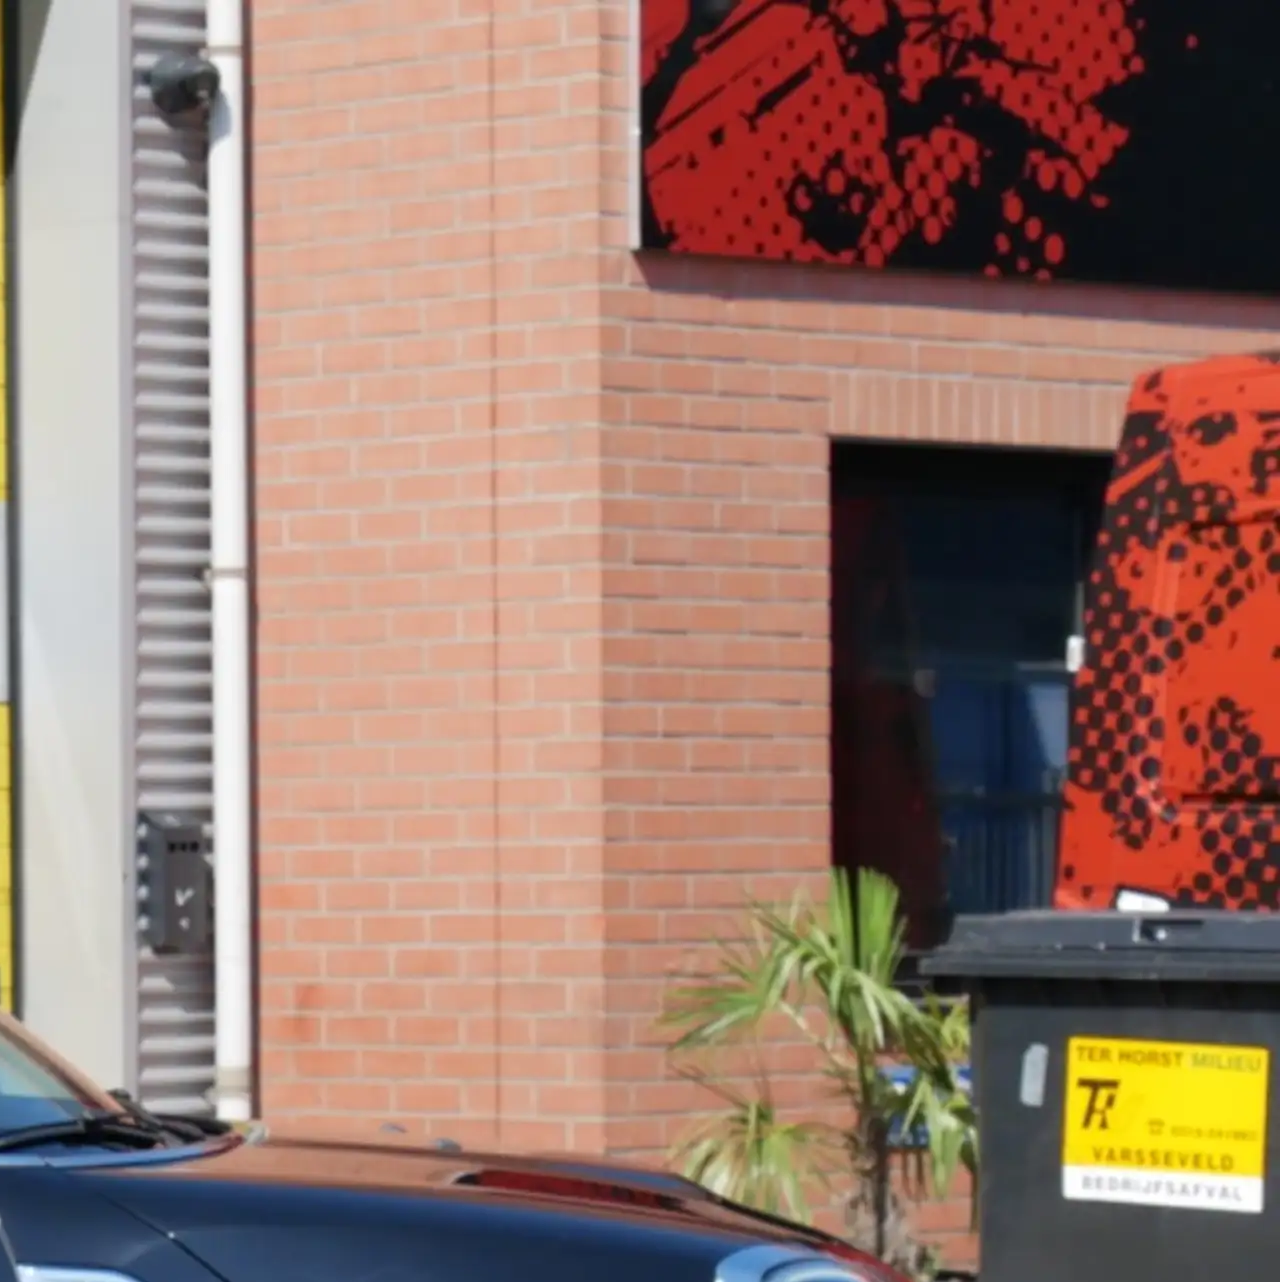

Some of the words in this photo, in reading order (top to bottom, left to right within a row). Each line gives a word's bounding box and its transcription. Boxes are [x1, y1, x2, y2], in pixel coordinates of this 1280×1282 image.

[1075, 1045, 1113, 1063] TER
[1118, 1048, 1184, 1068] HORST
[1190, 1052, 1262, 1073] MILIEU
[1092, 1146, 1235, 1172] VARSSEVELD
[1081, 1175, 1243, 1202] BEDRIJFSAFVAL
